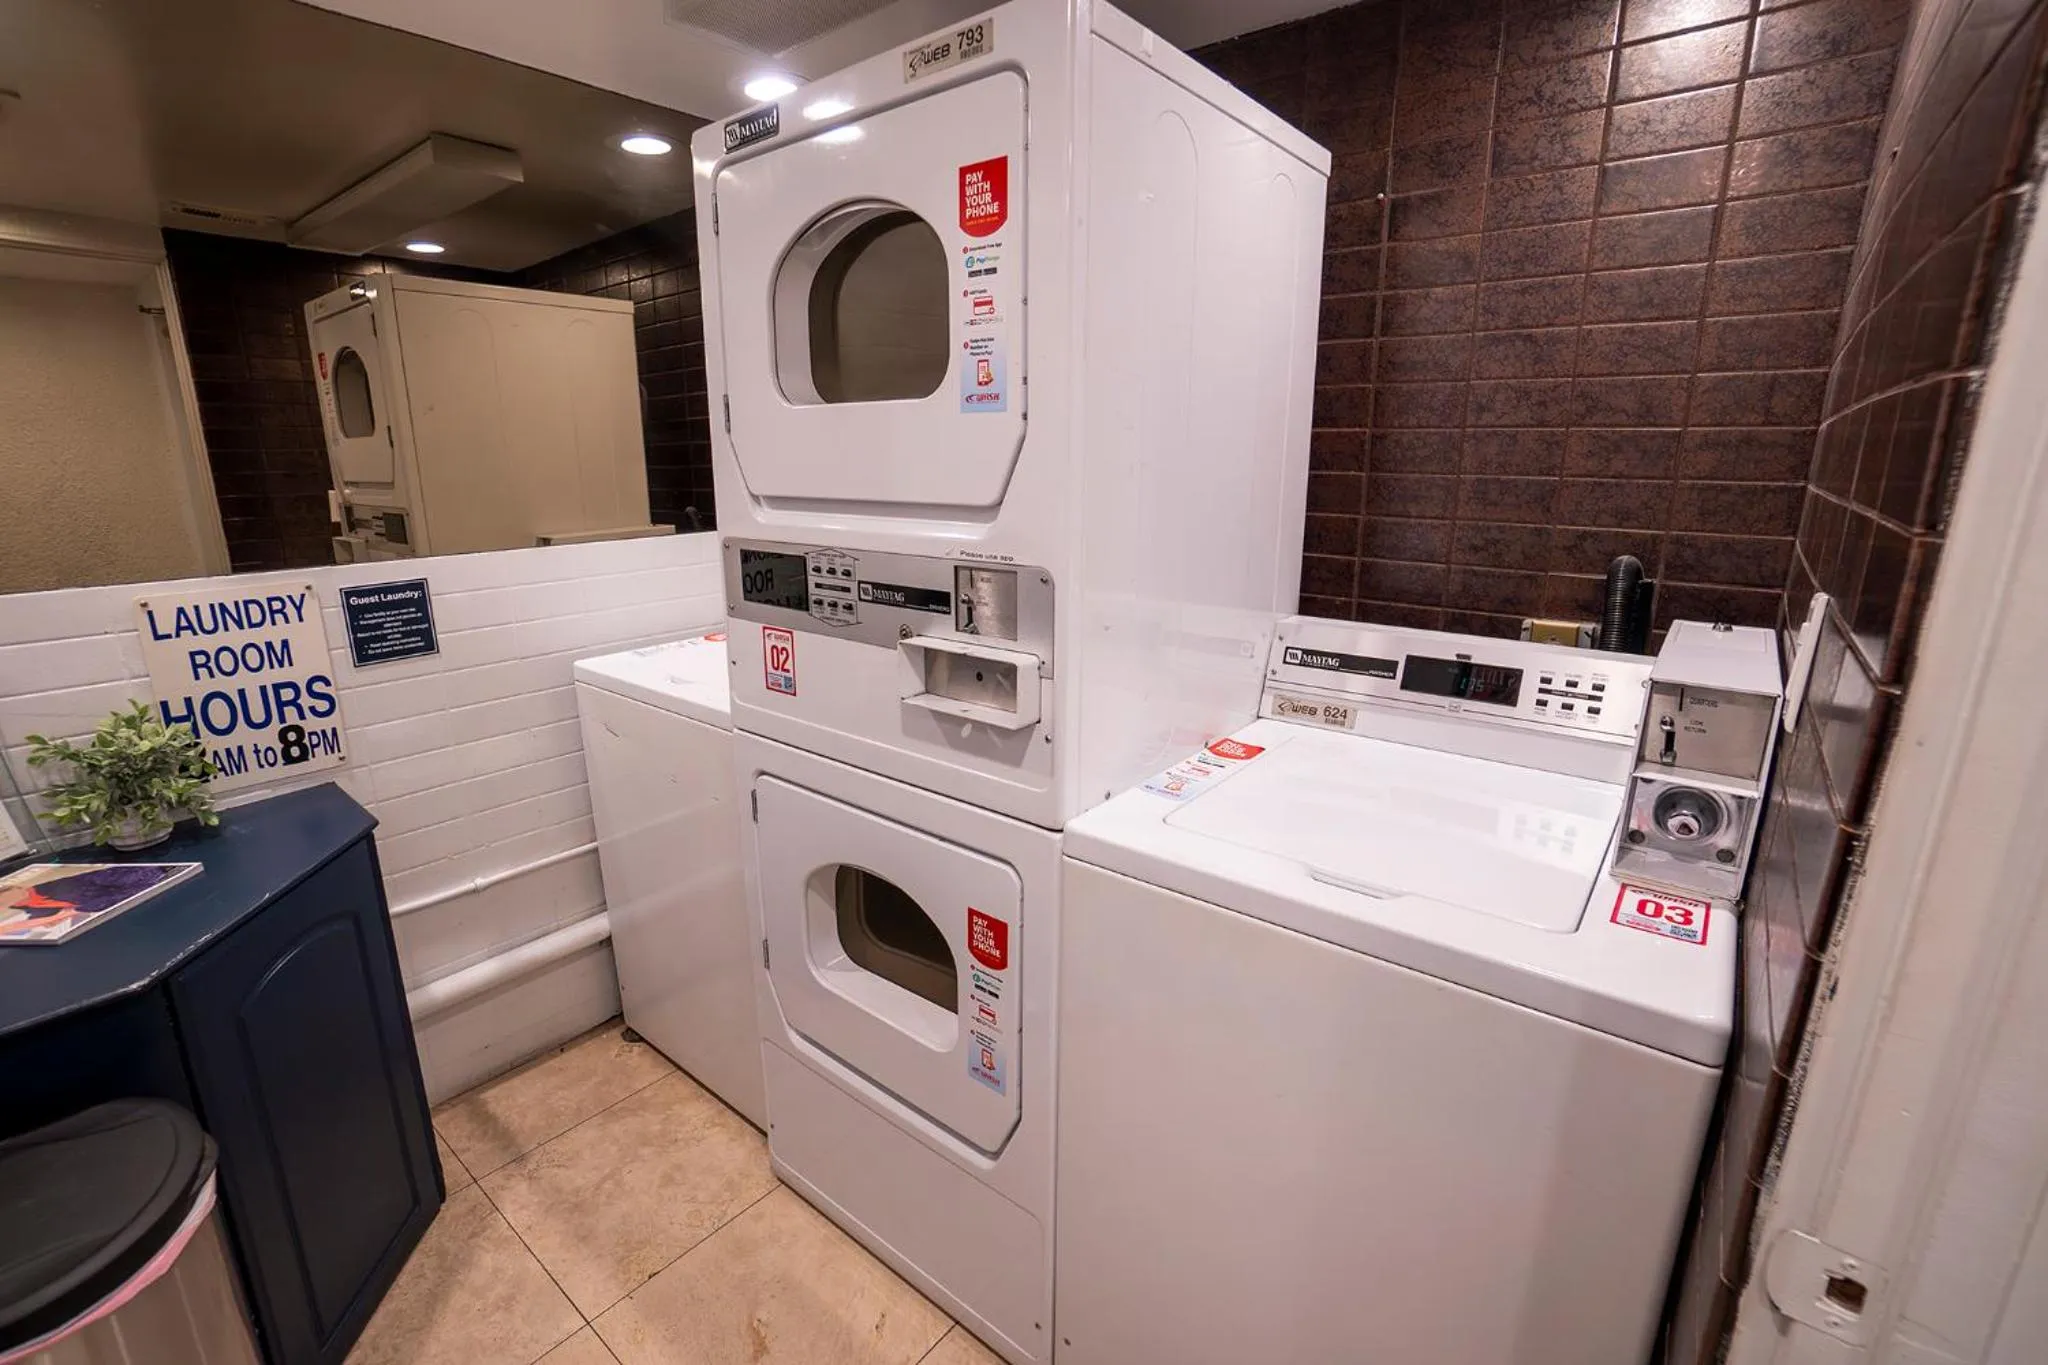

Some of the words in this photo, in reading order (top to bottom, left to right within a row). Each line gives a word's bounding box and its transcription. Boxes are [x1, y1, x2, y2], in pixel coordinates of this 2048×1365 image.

[956, 24, 984, 50] 793
[965, 170, 984, 185] PAY
[965, 180, 991, 196] WITH
[965, 192, 992, 207] YOUR
[966, 201, 1000, 219] PHONE
[350, 594, 380, 606] Guest
[380, 590, 423, 603] Laundry:
[873, 589, 905, 603] MAYTAG
[147, 593, 306, 641] LAUNDRY
[189, 638, 294, 681] ROOM
[771, 644, 790, 673] 02
[1302, 653, 1341, 667] MAYTAG
[159, 675, 337, 739] HOURS
[1323, 705, 1349, 719] 624
[253, 743, 278, 769] to
[1636, 899, 1694, 926] 03
[973, 915, 988, 928] PAY
[973, 931, 995, 948] YOUR
[973, 939, 1001, 959] PHONE
